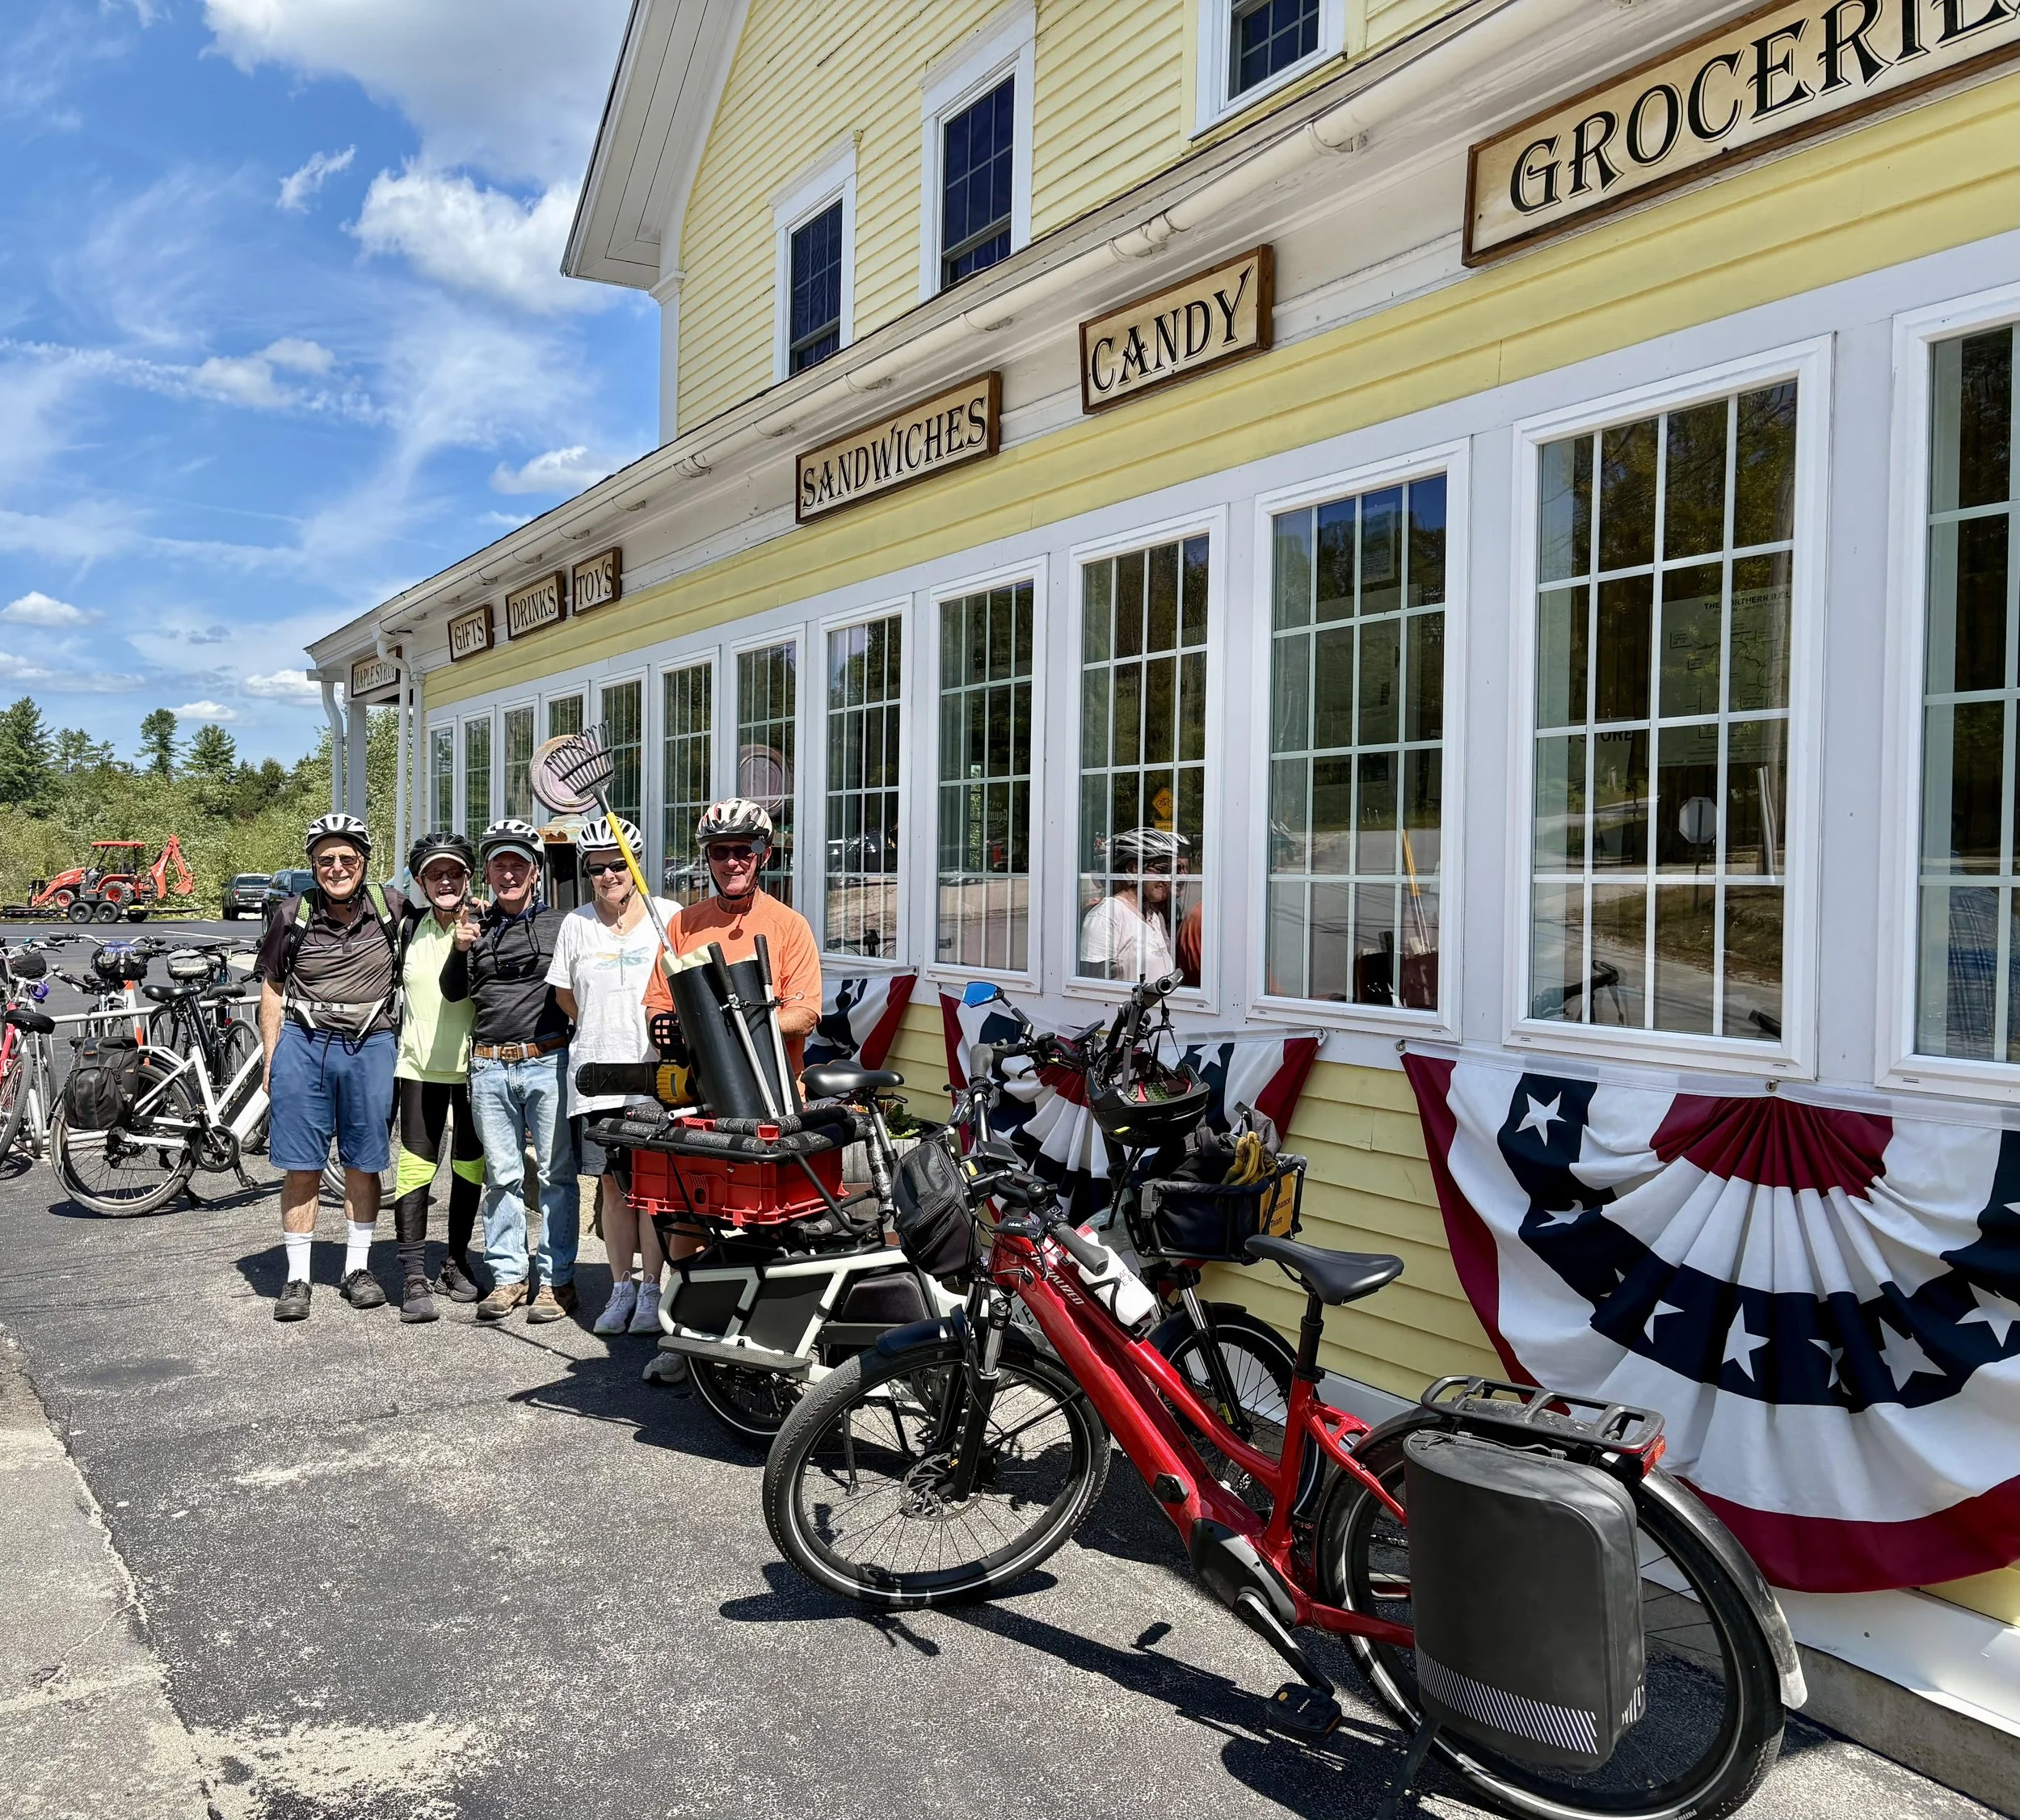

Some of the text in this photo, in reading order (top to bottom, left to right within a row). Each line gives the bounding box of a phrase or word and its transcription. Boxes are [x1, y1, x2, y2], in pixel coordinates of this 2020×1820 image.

[1091, 263, 1254, 394] CANDY
[801, 396, 987, 511] SANDWICHES
[576, 558, 613, 605] TOYS
[1730, 595, 1769, 606] ORTHERN
[1771, 592, 1791, 600] RIL
[512, 585, 556, 631] DRINKS
[454, 616, 484, 651] GIFTS
[355, 665, 375, 691] MAPLE
[1270, 1216, 1282, 1228] Team
